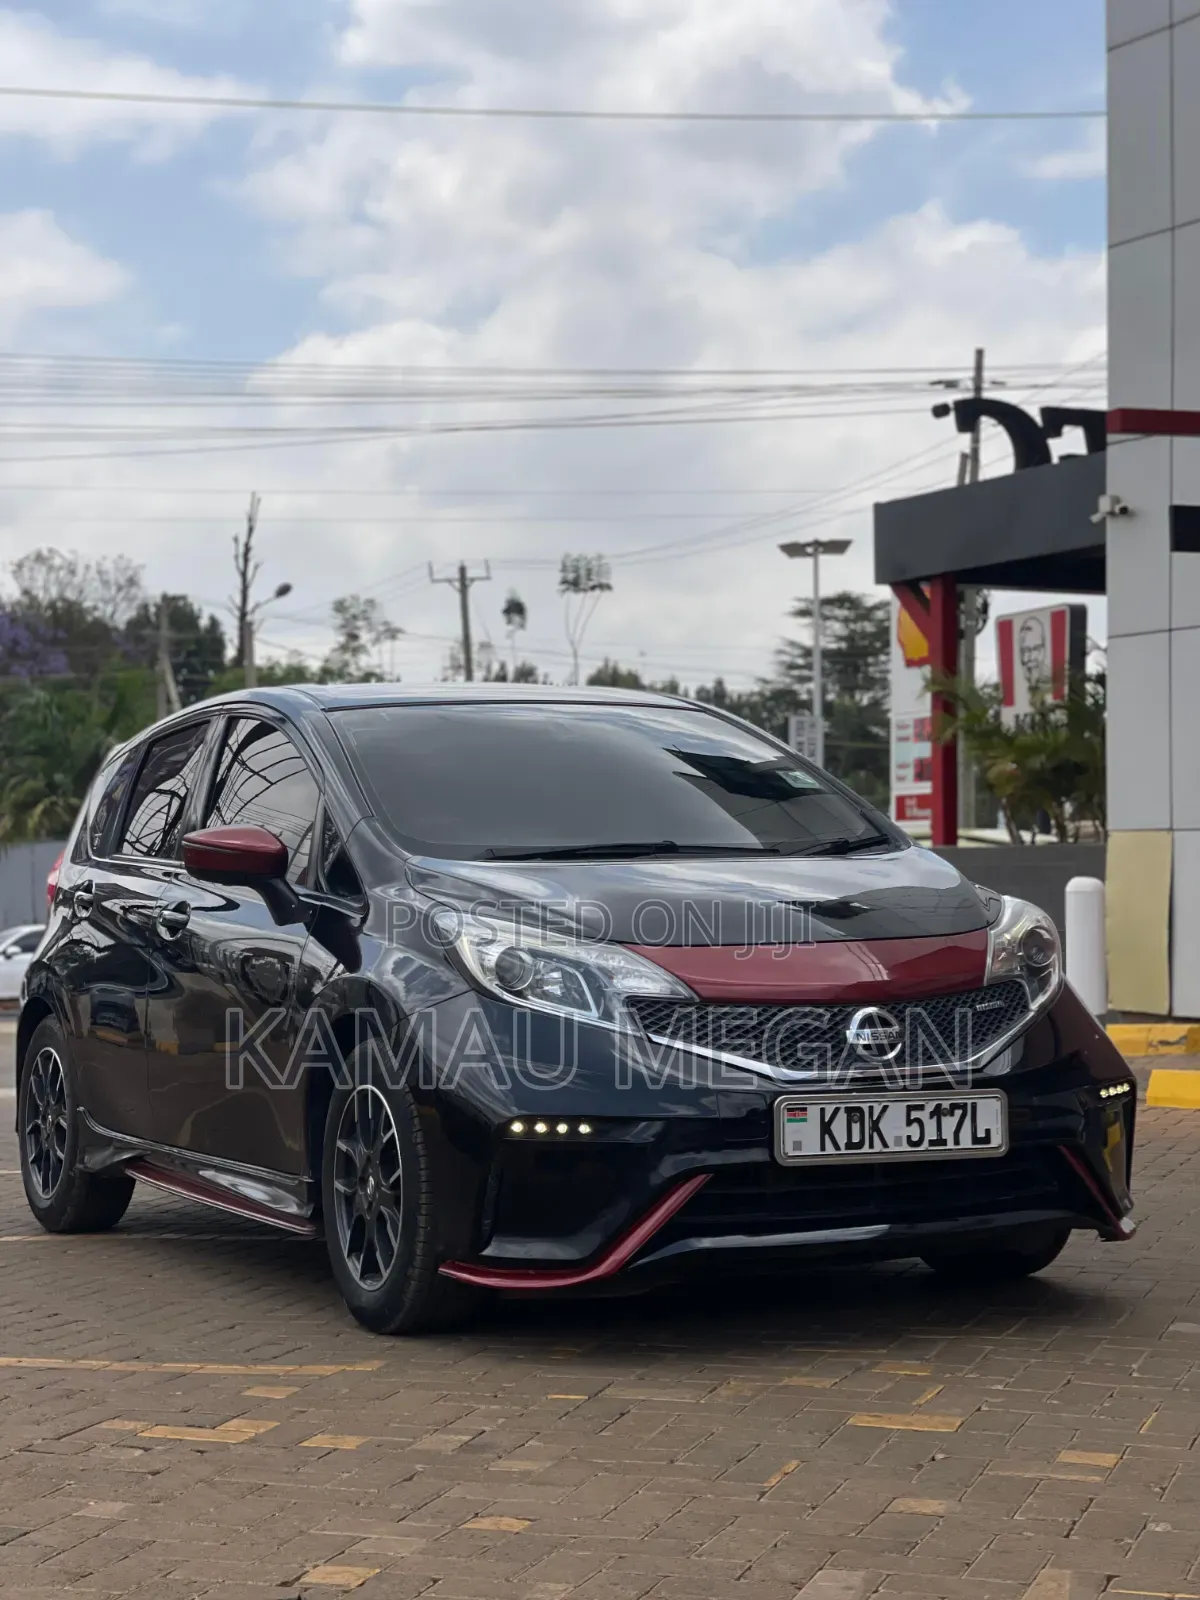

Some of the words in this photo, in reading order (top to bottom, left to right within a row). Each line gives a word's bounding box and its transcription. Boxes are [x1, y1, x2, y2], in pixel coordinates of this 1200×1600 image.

[855, 1030, 904, 1042] NISSAN
[819, 1104, 889, 1152] KDK
[905, 1101, 992, 1149] 517L
